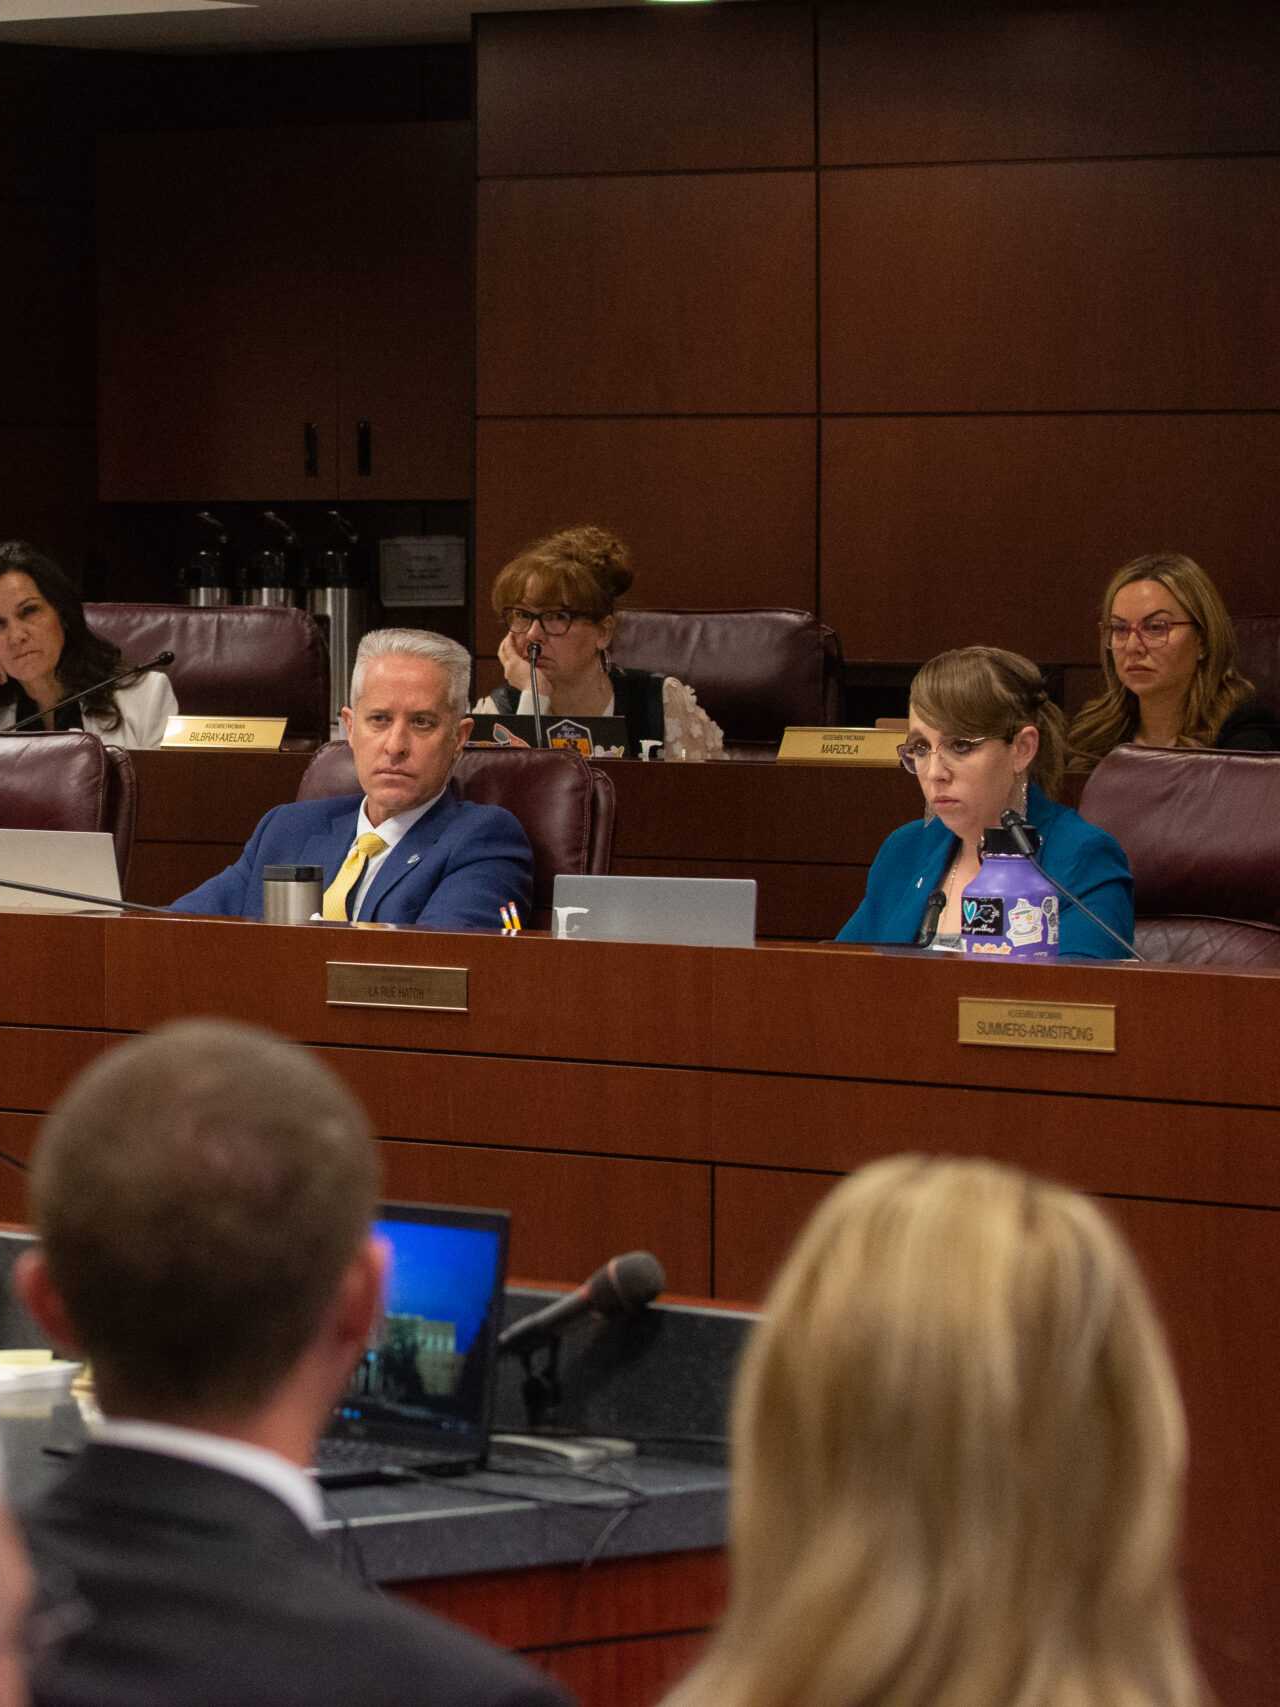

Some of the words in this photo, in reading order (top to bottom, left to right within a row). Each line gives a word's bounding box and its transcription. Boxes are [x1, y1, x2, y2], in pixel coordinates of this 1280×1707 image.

[189, 731, 255, 743] BILBRAY-AXELROD
[820, 743, 859, 755] MARZOLA
[976, 1020, 1094, 1042] SUMMERS-ARMSTRONG
